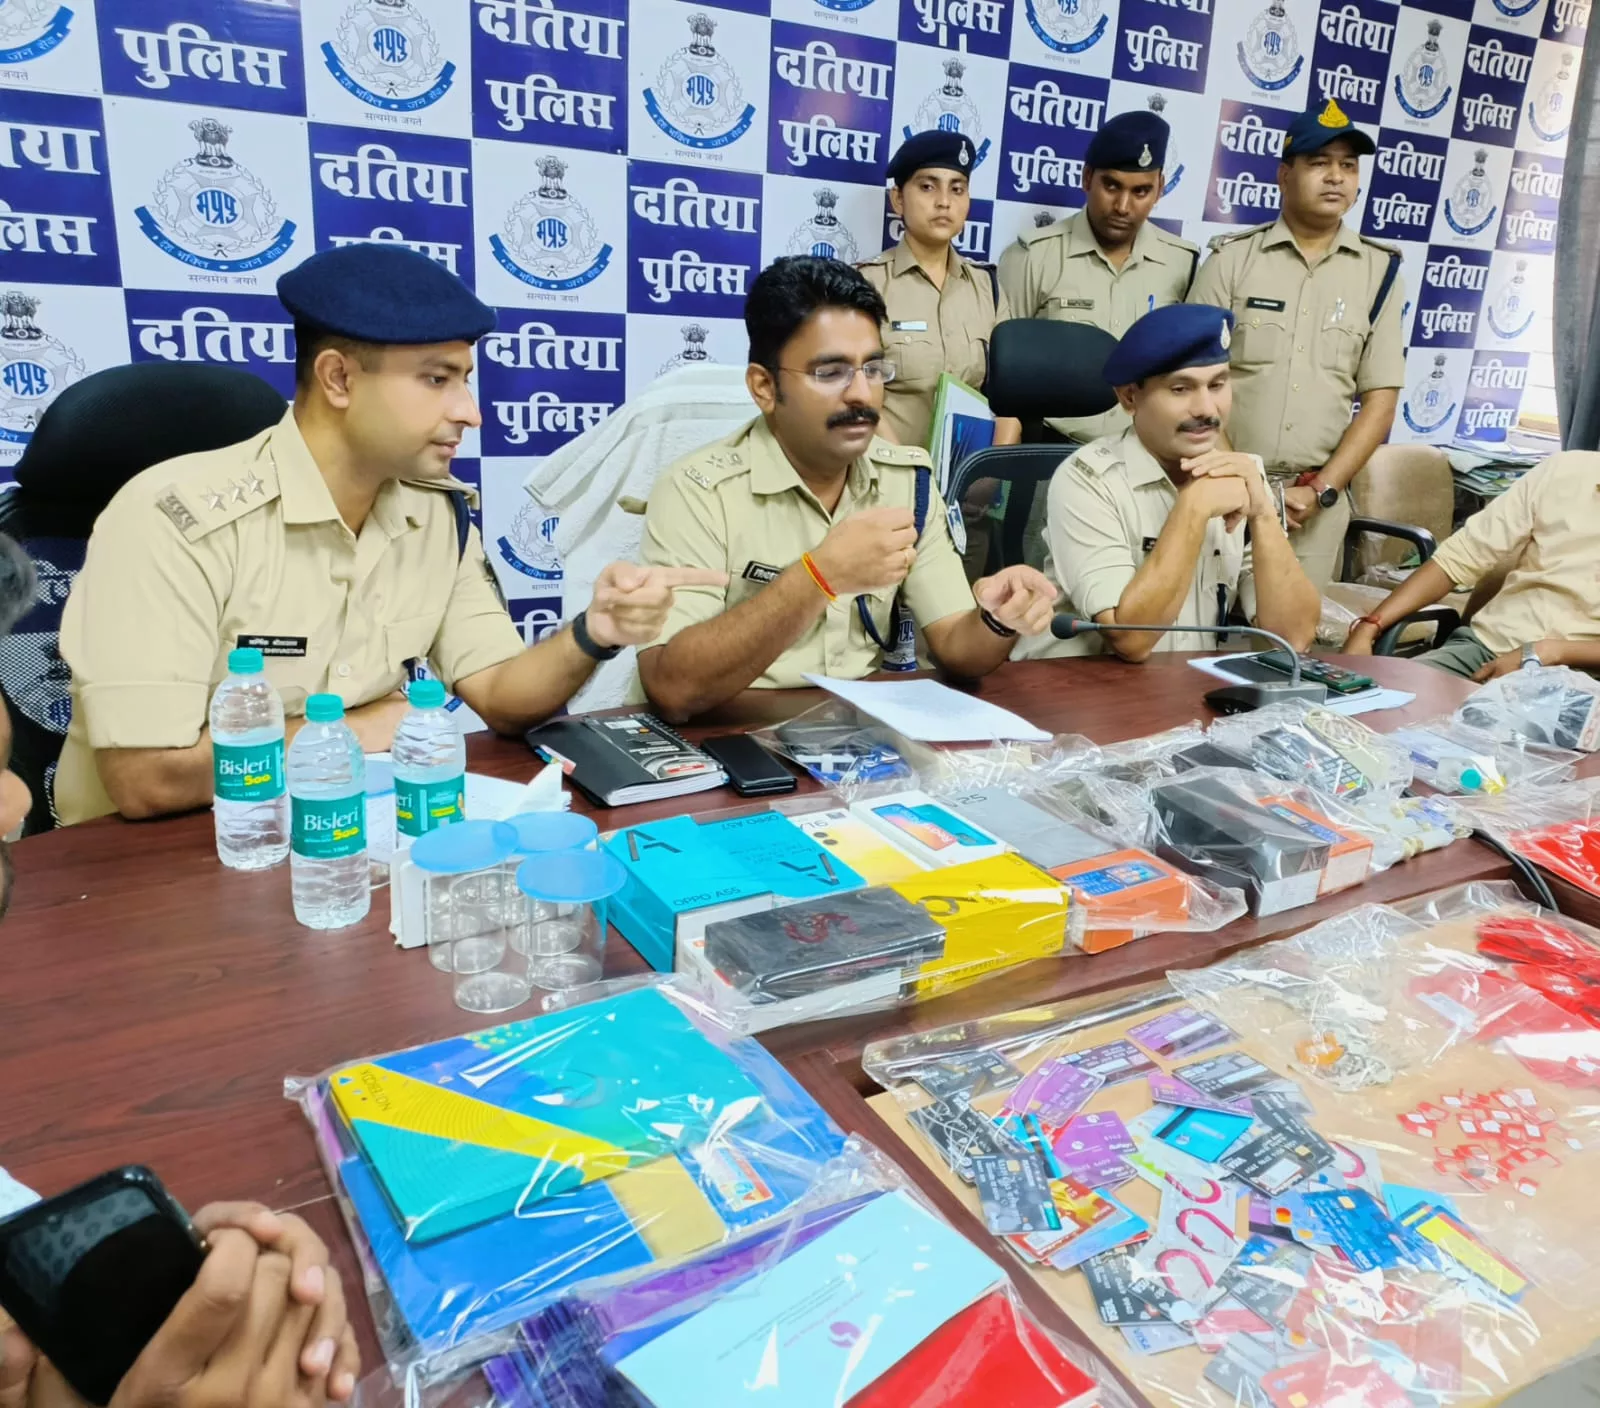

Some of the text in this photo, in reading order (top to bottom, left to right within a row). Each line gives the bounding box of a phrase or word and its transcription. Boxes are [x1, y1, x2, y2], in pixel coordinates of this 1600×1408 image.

[478, 0, 625, 59] दतिया
[914, 0, 1004, 34] पुलिस
[1320, 4, 1394, 53] दतिया
[114, 22, 288, 89] पुलिस
[1124, 24, 1204, 72] पुलिस
[1467, 39, 1532, 83] दतिया
[774, 40, 893, 101] दतिया
[1317, 64, 1381, 106] पुलिस
[484, 73, 617, 132] पुलिस
[1009, 80, 1105, 132] दतिया
[1462, 93, 1516, 131] पुलिस
[778, 112, 882, 167] पुलिस
[1221, 115, 1288, 158] दतिय
[313, 143, 469, 208] दतिया
[1377, 141, 1445, 181] दतिया
[629, 177, 760, 234] दतिया
[1372, 192, 1432, 230] पुलिस
[1506, 210, 1556, 245] पुलिस
[638, 249, 751, 303] पुलिस
[1425, 255, 1489, 290] दतिया
[132, 306, 296, 362] दतिय
[1421, 304, 1476, 339] पुलिस
[484, 321, 623, 372] दतिया
[1470, 359, 1529, 390] दतिया
[491, 391, 614, 445] पुलिस
[1465, 402, 1515, 437] पुलिस
[219, 755, 271, 776] Bisleri
[303, 806, 359, 831] Bisleri
[673, 887, 742, 906] OPPO A55
